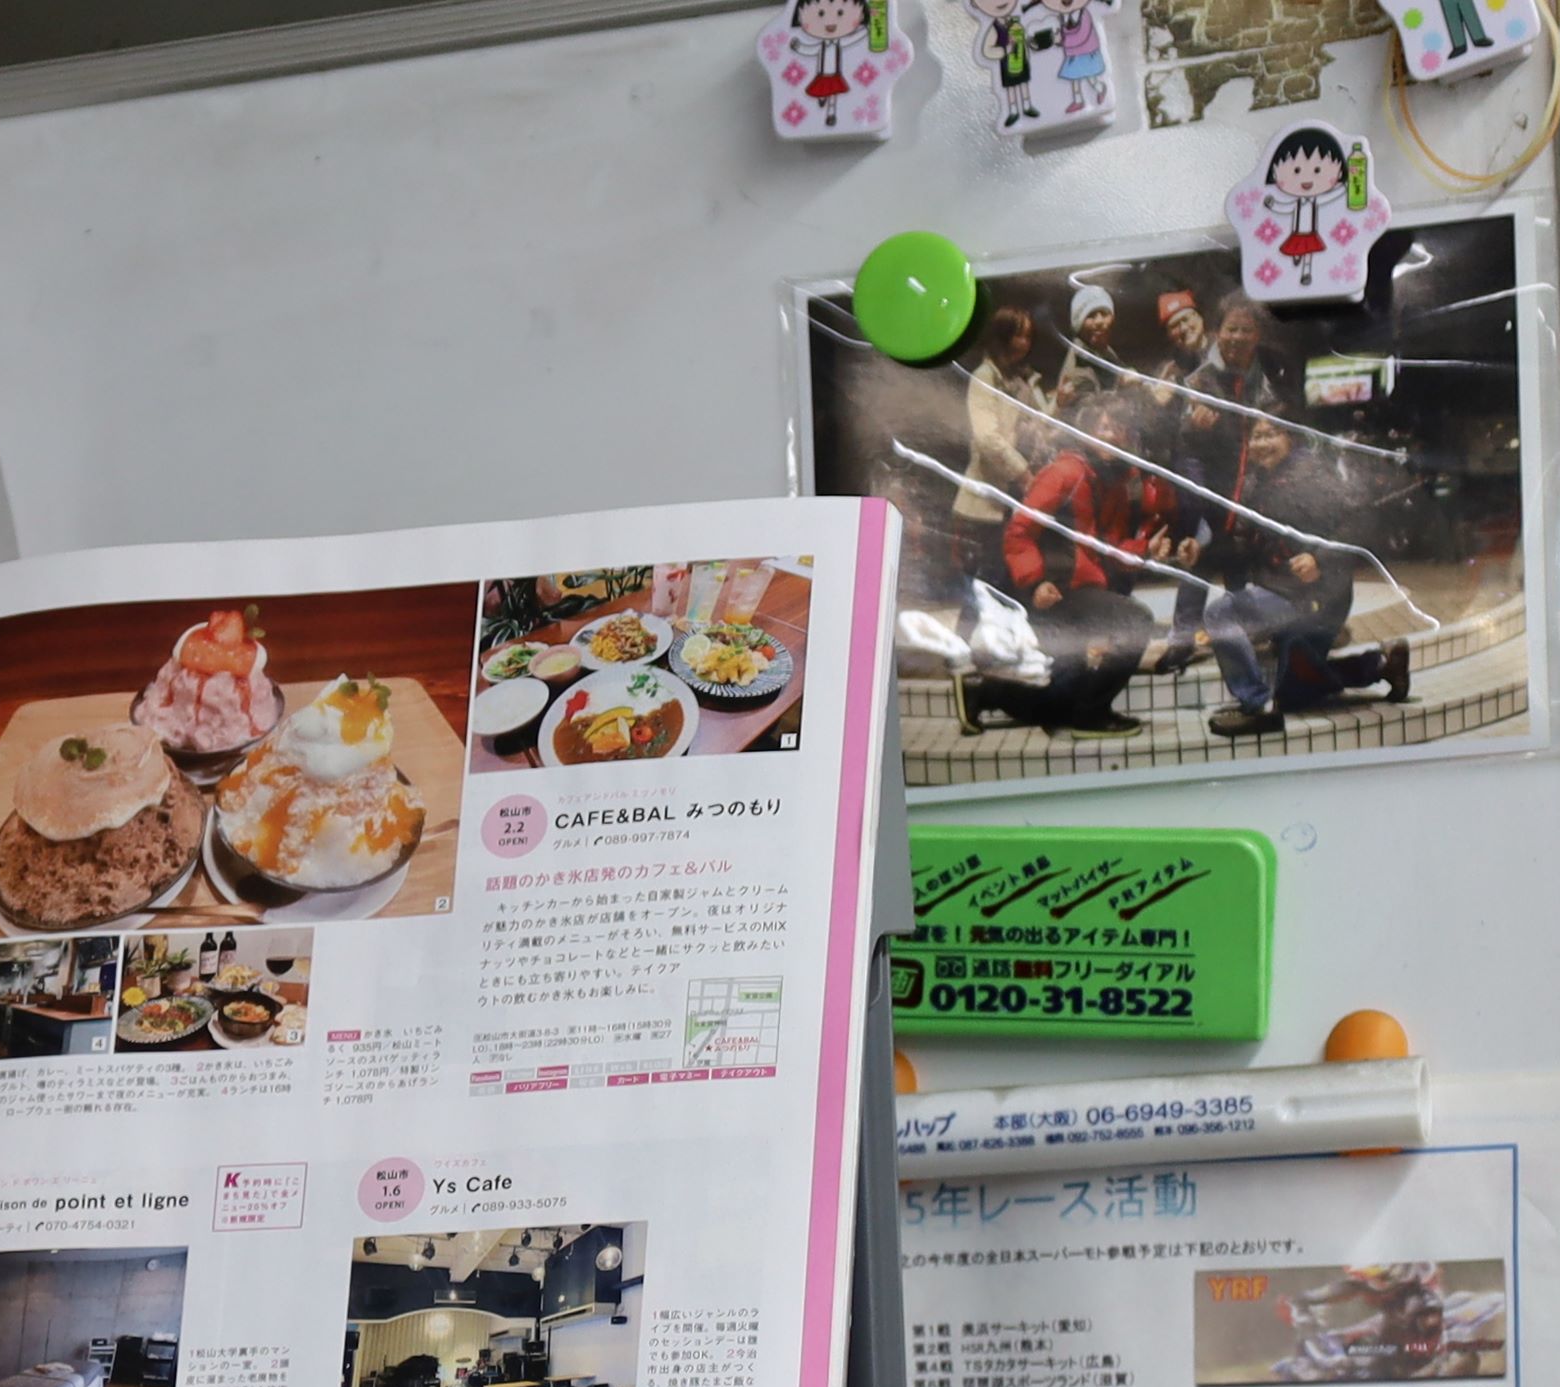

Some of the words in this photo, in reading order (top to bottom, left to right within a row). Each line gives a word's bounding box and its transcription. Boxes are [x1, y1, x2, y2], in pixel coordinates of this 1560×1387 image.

[498, 806, 532, 819] 松山市
[554, 804, 677, 831] CAFE&BAL
[686, 798, 781, 818] みつのもり
[504, 820, 525, 834] 2.2
[498, 836, 528, 847] OPEN!
[929, 984, 1193, 1017] 0120-31-8522
[1086, 1096, 1253, 1126] 06-6949-3385
[432, 1177, 457, 1195] Ys
[466, 1175, 513, 1193] Cafe
[32, 1198, 48, 1209] de
[55, 1192, 110, 1213] point
[114, 1193, 137, 1208] et
[141, 1192, 189, 1212] ligne
[1208, 1276, 1269, 1302] YRF
